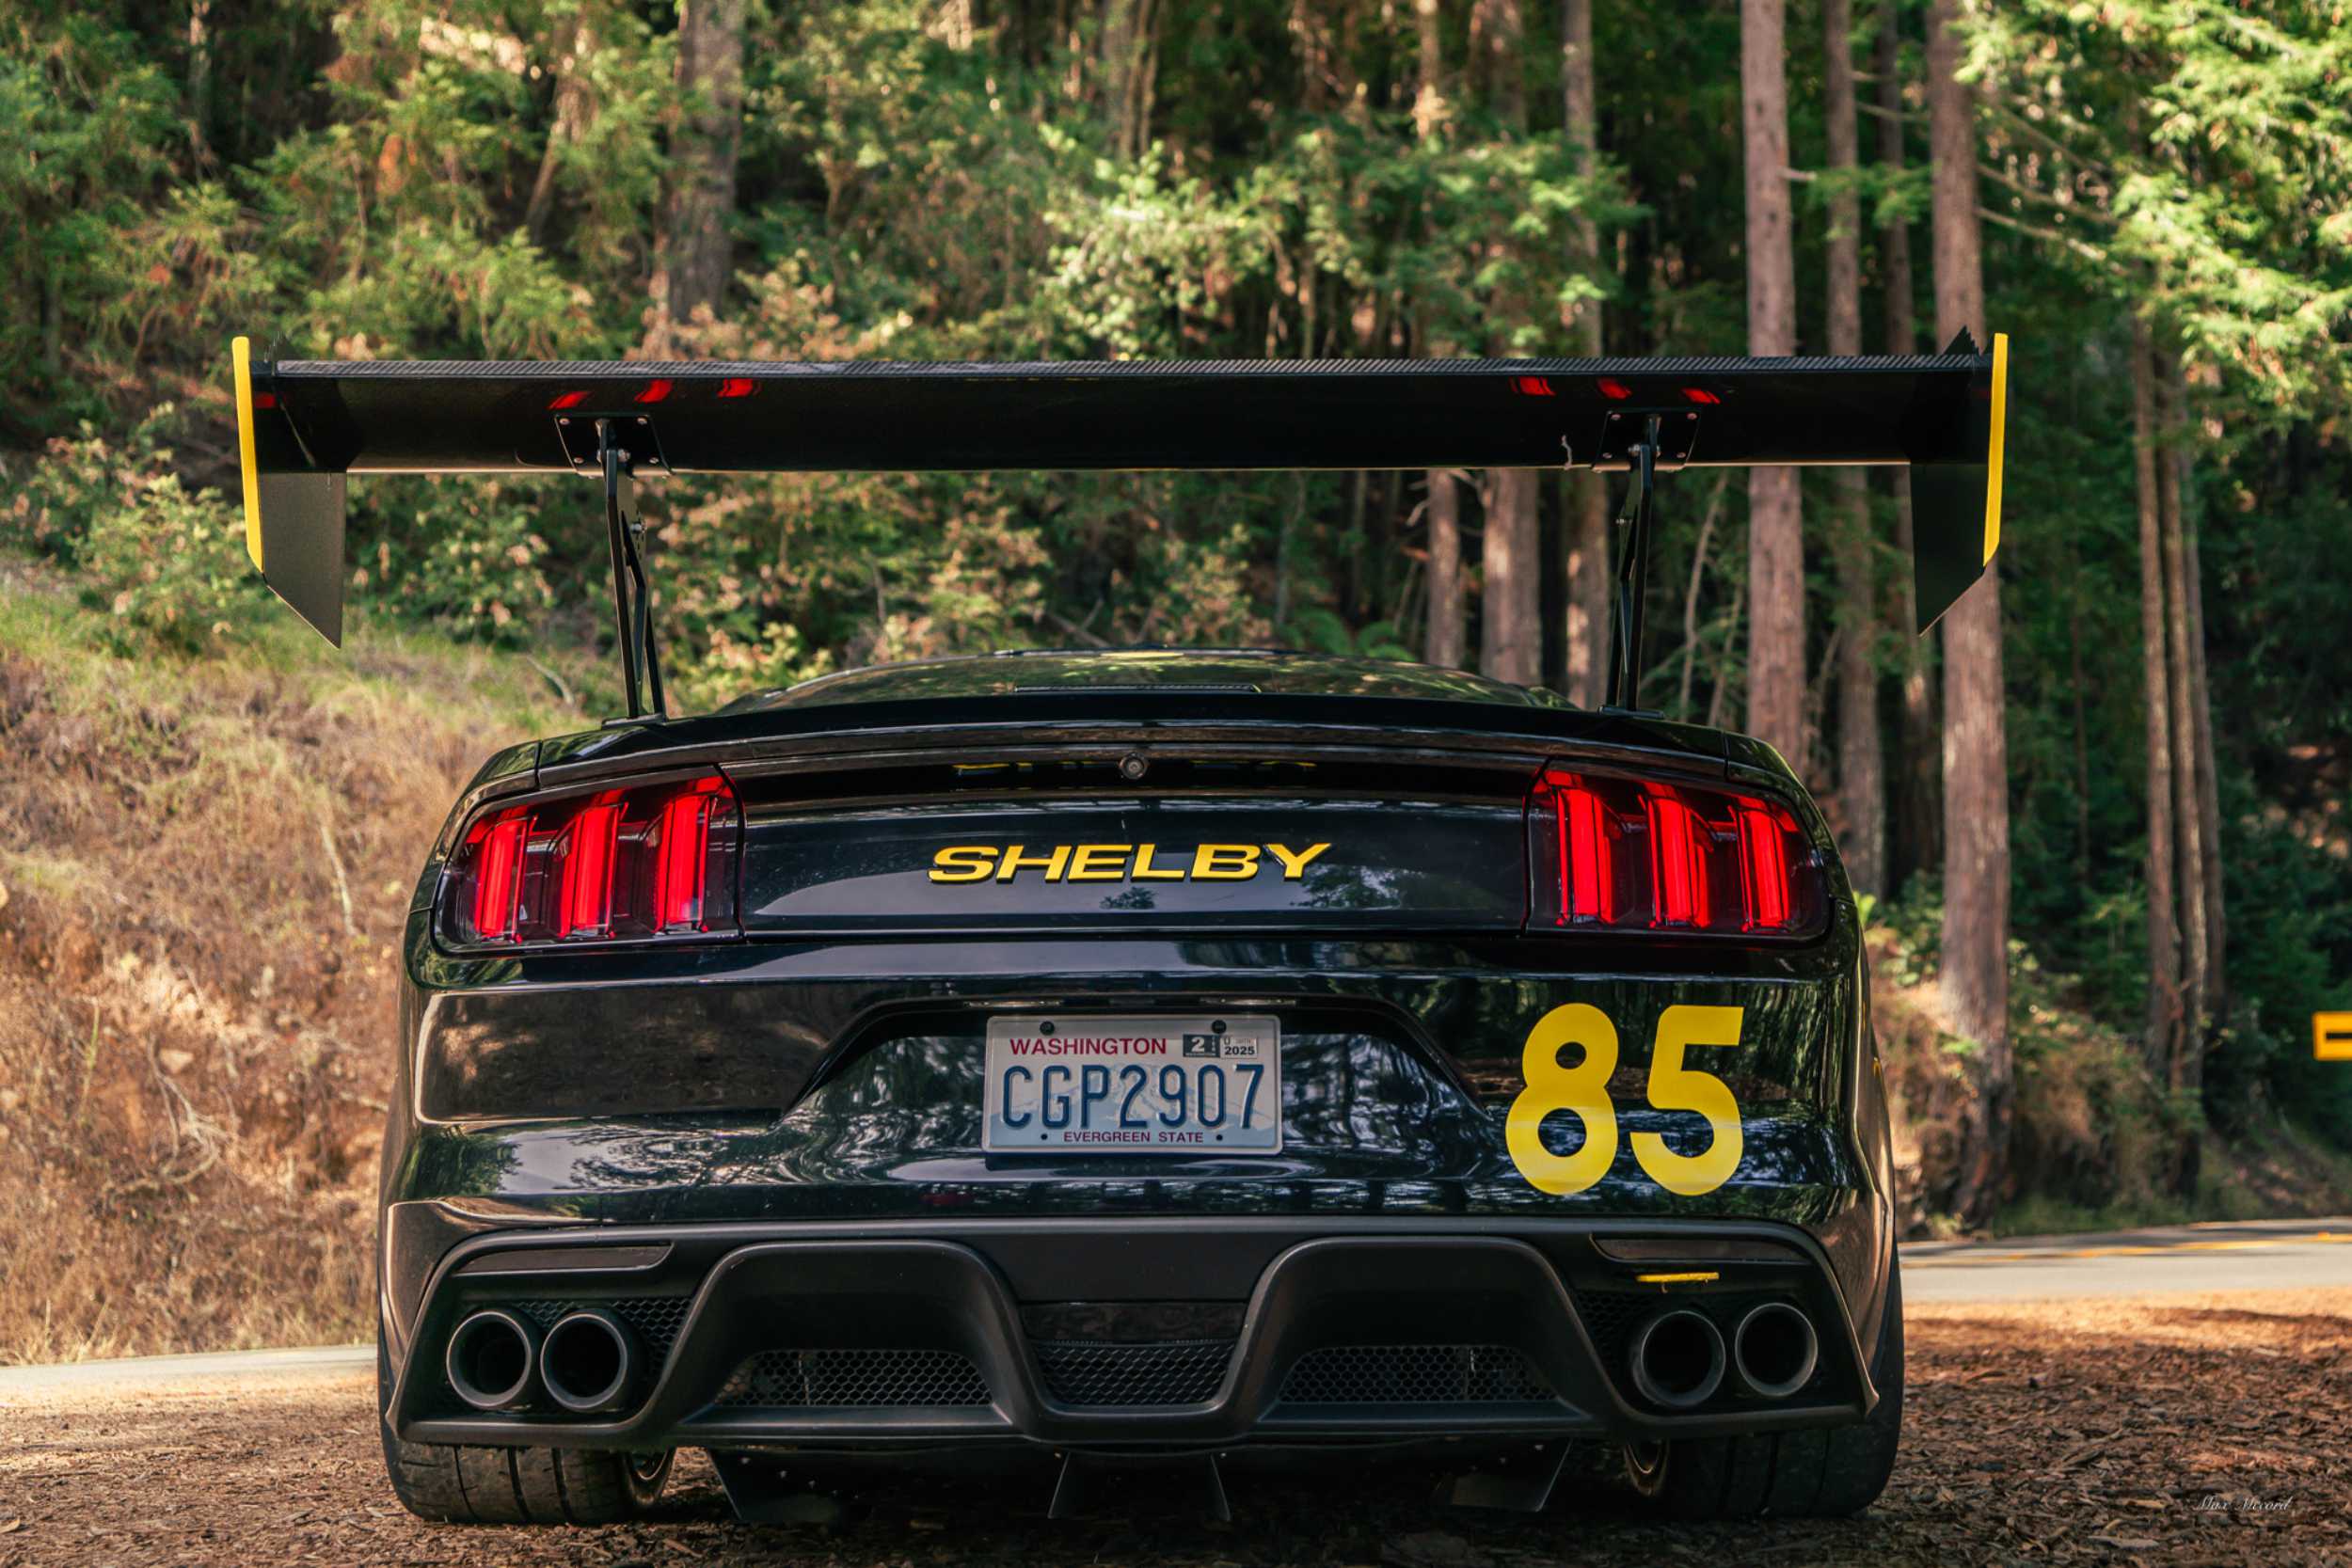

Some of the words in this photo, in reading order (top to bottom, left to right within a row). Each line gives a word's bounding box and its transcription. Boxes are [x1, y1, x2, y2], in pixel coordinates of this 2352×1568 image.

[927, 843, 1331, 883] SHELBY
[1009, 1037, 1167, 1055] WASHINGTON
[1191, 1037, 1205, 1053] 2
[1224, 1045, 1256, 1055] 2025
[1003, 1064, 1264, 1129] CGP2907
[1505, 1002, 1744, 1196] 85
[1063, 1132, 1151, 1143] EVERGREEN
[1158, 1132, 1204, 1143] STATE
